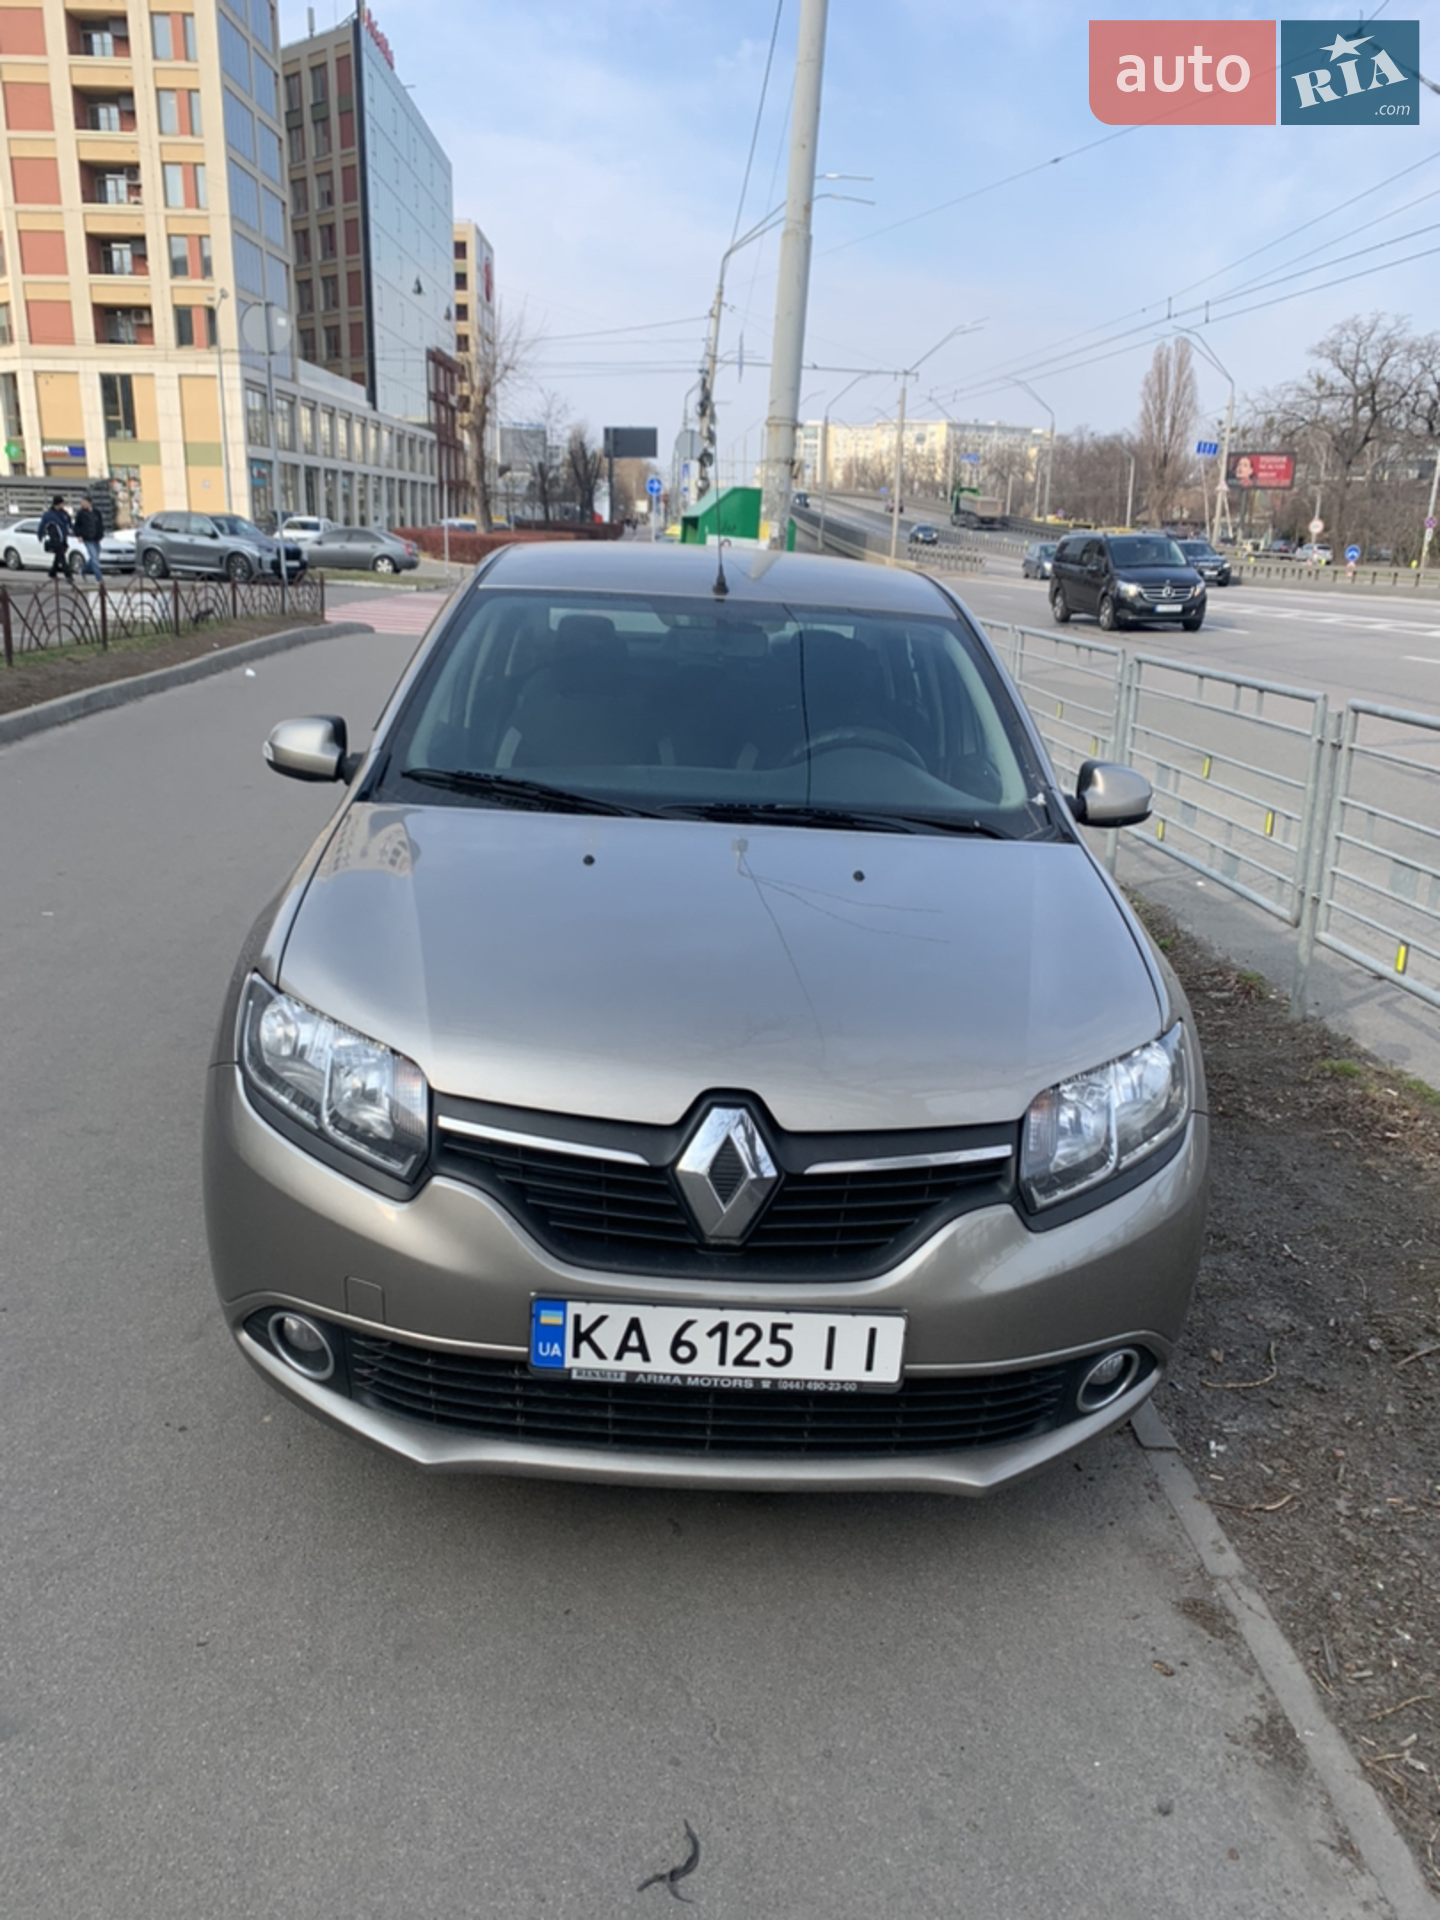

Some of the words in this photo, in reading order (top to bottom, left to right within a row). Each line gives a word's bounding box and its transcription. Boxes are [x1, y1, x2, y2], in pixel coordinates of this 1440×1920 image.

[571, 1313, 651, 1363] KA
[669, 1319, 794, 1368] 6125
[538, 1341, 562, 1357] UA
[635, 1373, 682, 1384] ARMA
[686, 1376, 754, 1389] MOTORS
